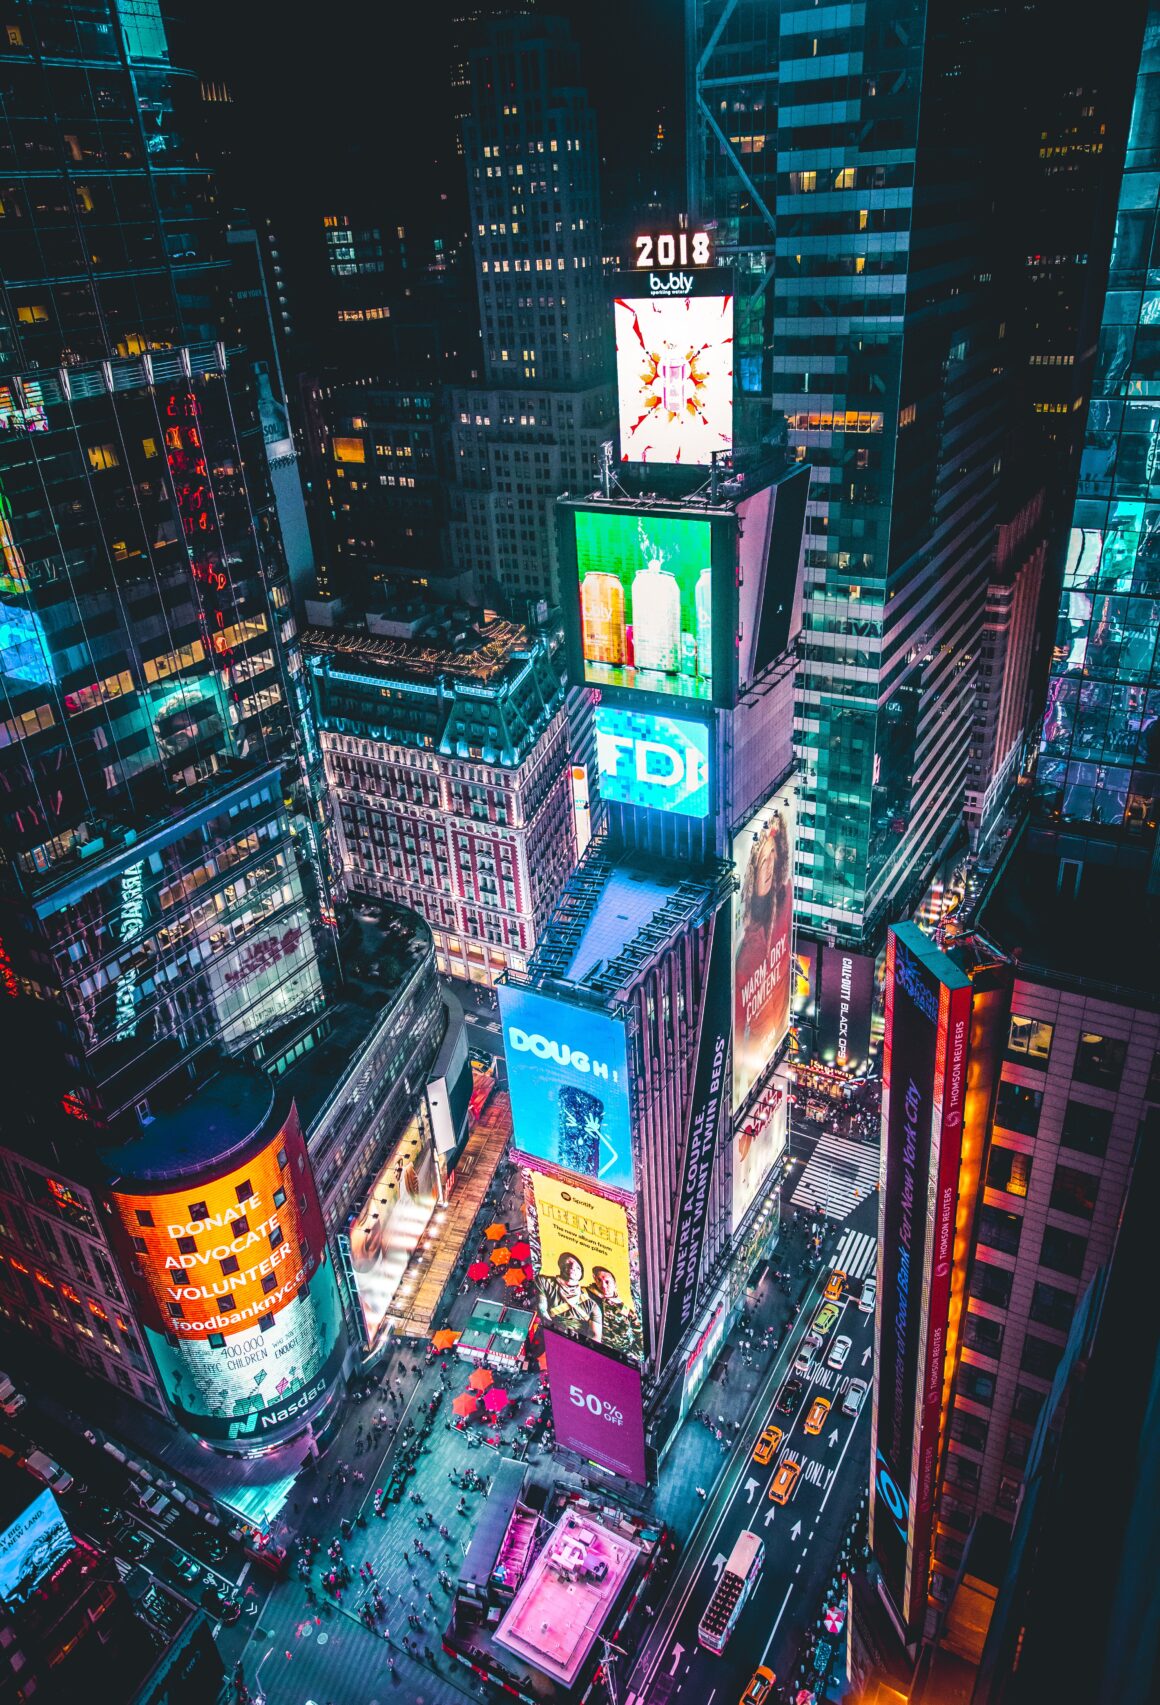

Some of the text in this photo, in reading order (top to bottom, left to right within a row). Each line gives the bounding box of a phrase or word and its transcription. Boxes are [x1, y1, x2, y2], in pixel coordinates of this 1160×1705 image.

[636, 232, 710, 267] 2018
[649, 271, 694, 293] bubly
[839, 1002, 849, 1037] BLACK
[837, 1038, 847, 1058] OPS
[950, 1020, 964, 1107] THOMSON REUTERS
[905, 1078, 922, 1124] City
[702, 1098, 718, 1156] TWIN
[686, 1105, 706, 1193] COUPLE.
[903, 1123, 917, 1169] York
[572, 1196, 595, 1210] Spotify
[684, 1196, 694, 1212] A
[693, 1161, 709, 1223] WANT
[901, 1168, 914, 1218] New
[167, 1191, 262, 1239] DONATE
[539, 1199, 625, 1247] TRENCH
[899, 1214, 911, 1249] For
[939, 1187, 952, 1260] THOMSON REUTERS
[164, 1213, 280, 1269] ADVOCATE
[578, 1233, 597, 1246] album
[685, 1226, 701, 1289] DON'T
[167, 1242, 292, 1300] VOLUNTEER
[897, 1246, 911, 1295] Bank
[680, 1289, 693, 1325] WE
[220, 1335, 264, 1359] 400,000
[227, 1348, 268, 1371] CHILDREN
[930, 1327, 942, 1391] THOMSON REUTERS
[815, 1366, 842, 1391] ONLY
[261, 1378, 326, 1428] Nasdaq
[570, 1384, 623, 1420] 50%
[603, 1413, 624, 1426] OFF
[804, 1460, 833, 1490] ONLY
[7, 1524, 21, 1539] BIG
[7, 1530, 24, 1546] NEW
